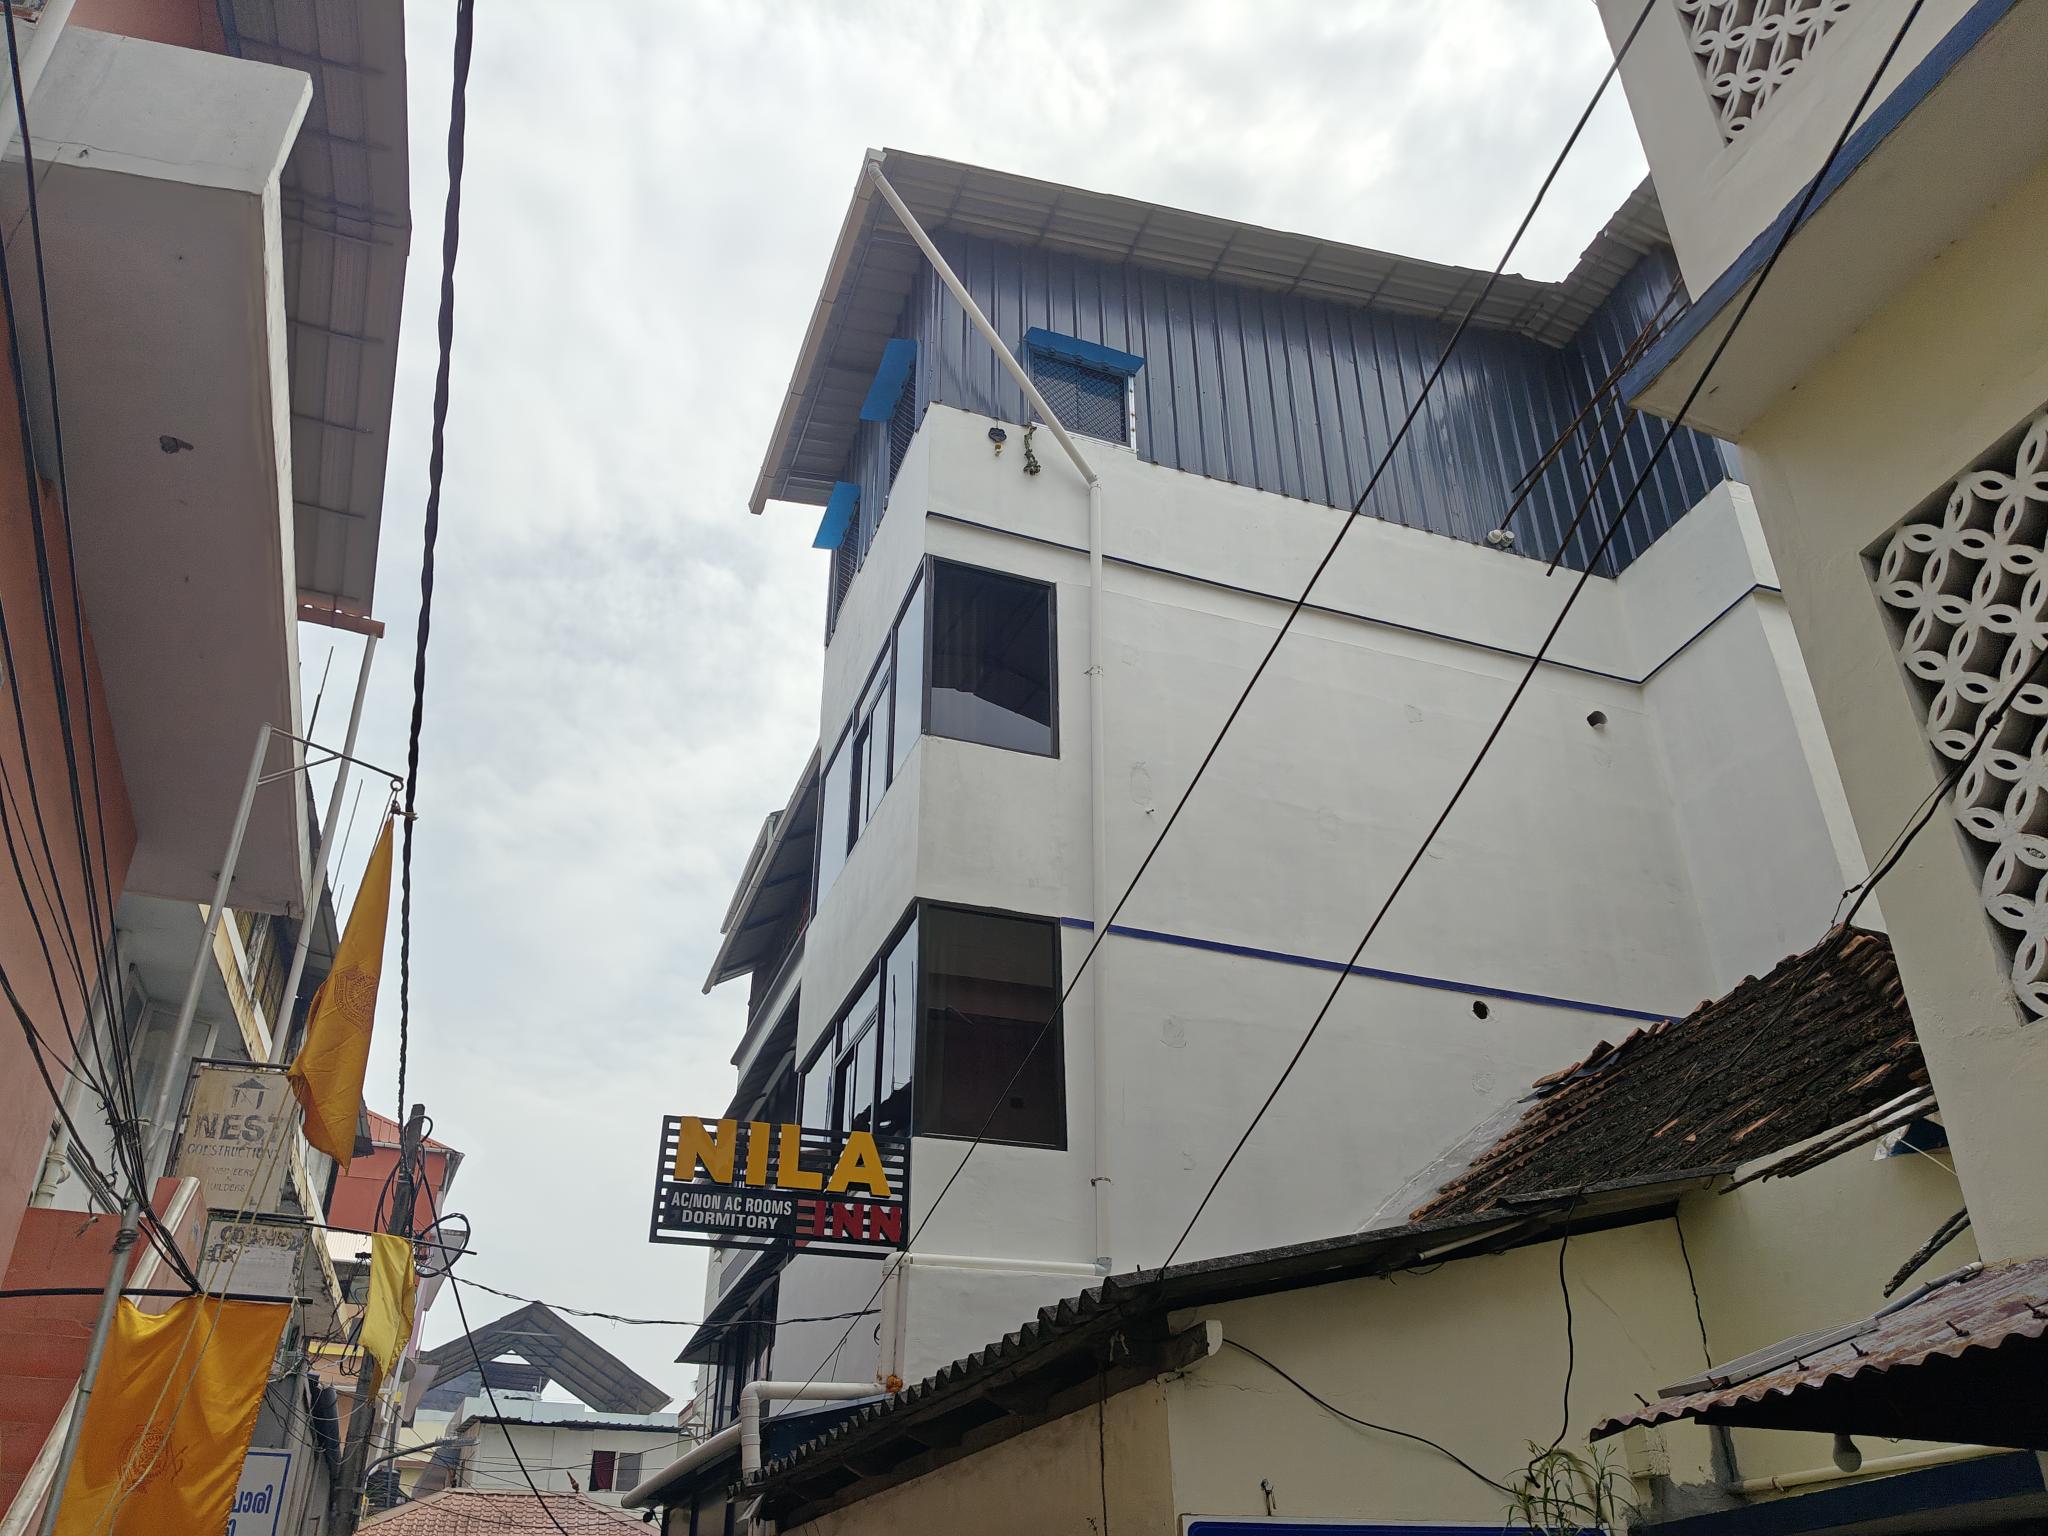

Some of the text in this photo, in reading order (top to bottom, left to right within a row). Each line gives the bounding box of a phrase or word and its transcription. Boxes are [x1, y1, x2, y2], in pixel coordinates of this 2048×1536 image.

[673, 1115, 892, 1198] NILA
[671, 1191, 793, 1216] AC/NON AC ROOMS
[681, 1209, 778, 1230] DORMITORY
[811, 1199, 901, 1244] INN
